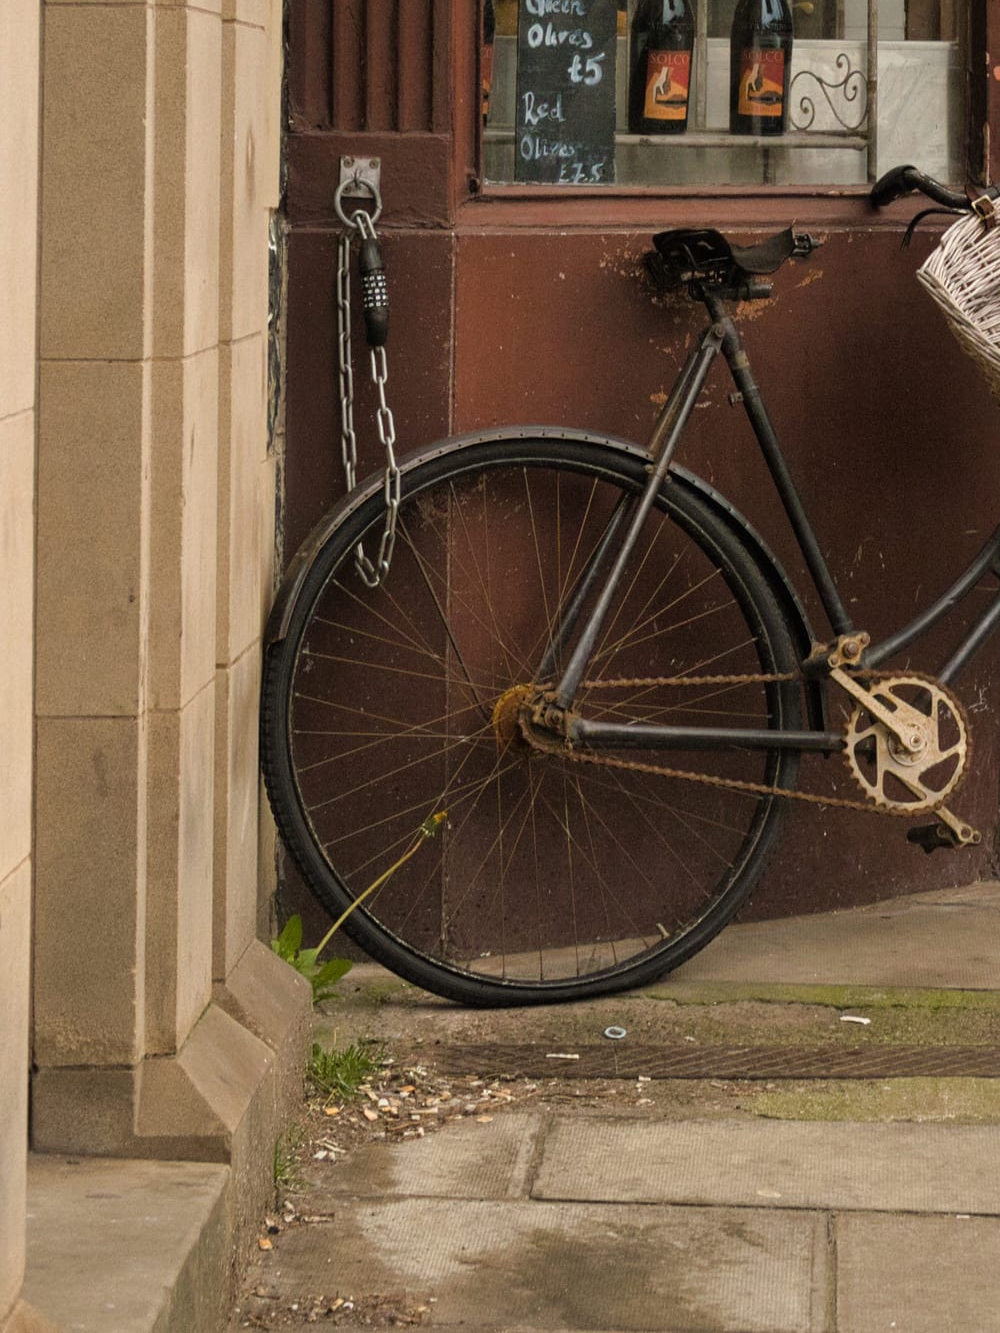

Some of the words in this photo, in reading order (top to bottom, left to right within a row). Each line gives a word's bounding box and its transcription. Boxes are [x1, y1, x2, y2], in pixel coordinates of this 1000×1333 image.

[527, 22, 593, 48] Olives
[567, 52, 606, 85] £5
[650, 52, 690, 66] SOLCO
[522, 91, 567, 125] Red
[520, 135, 576, 160] Olives
